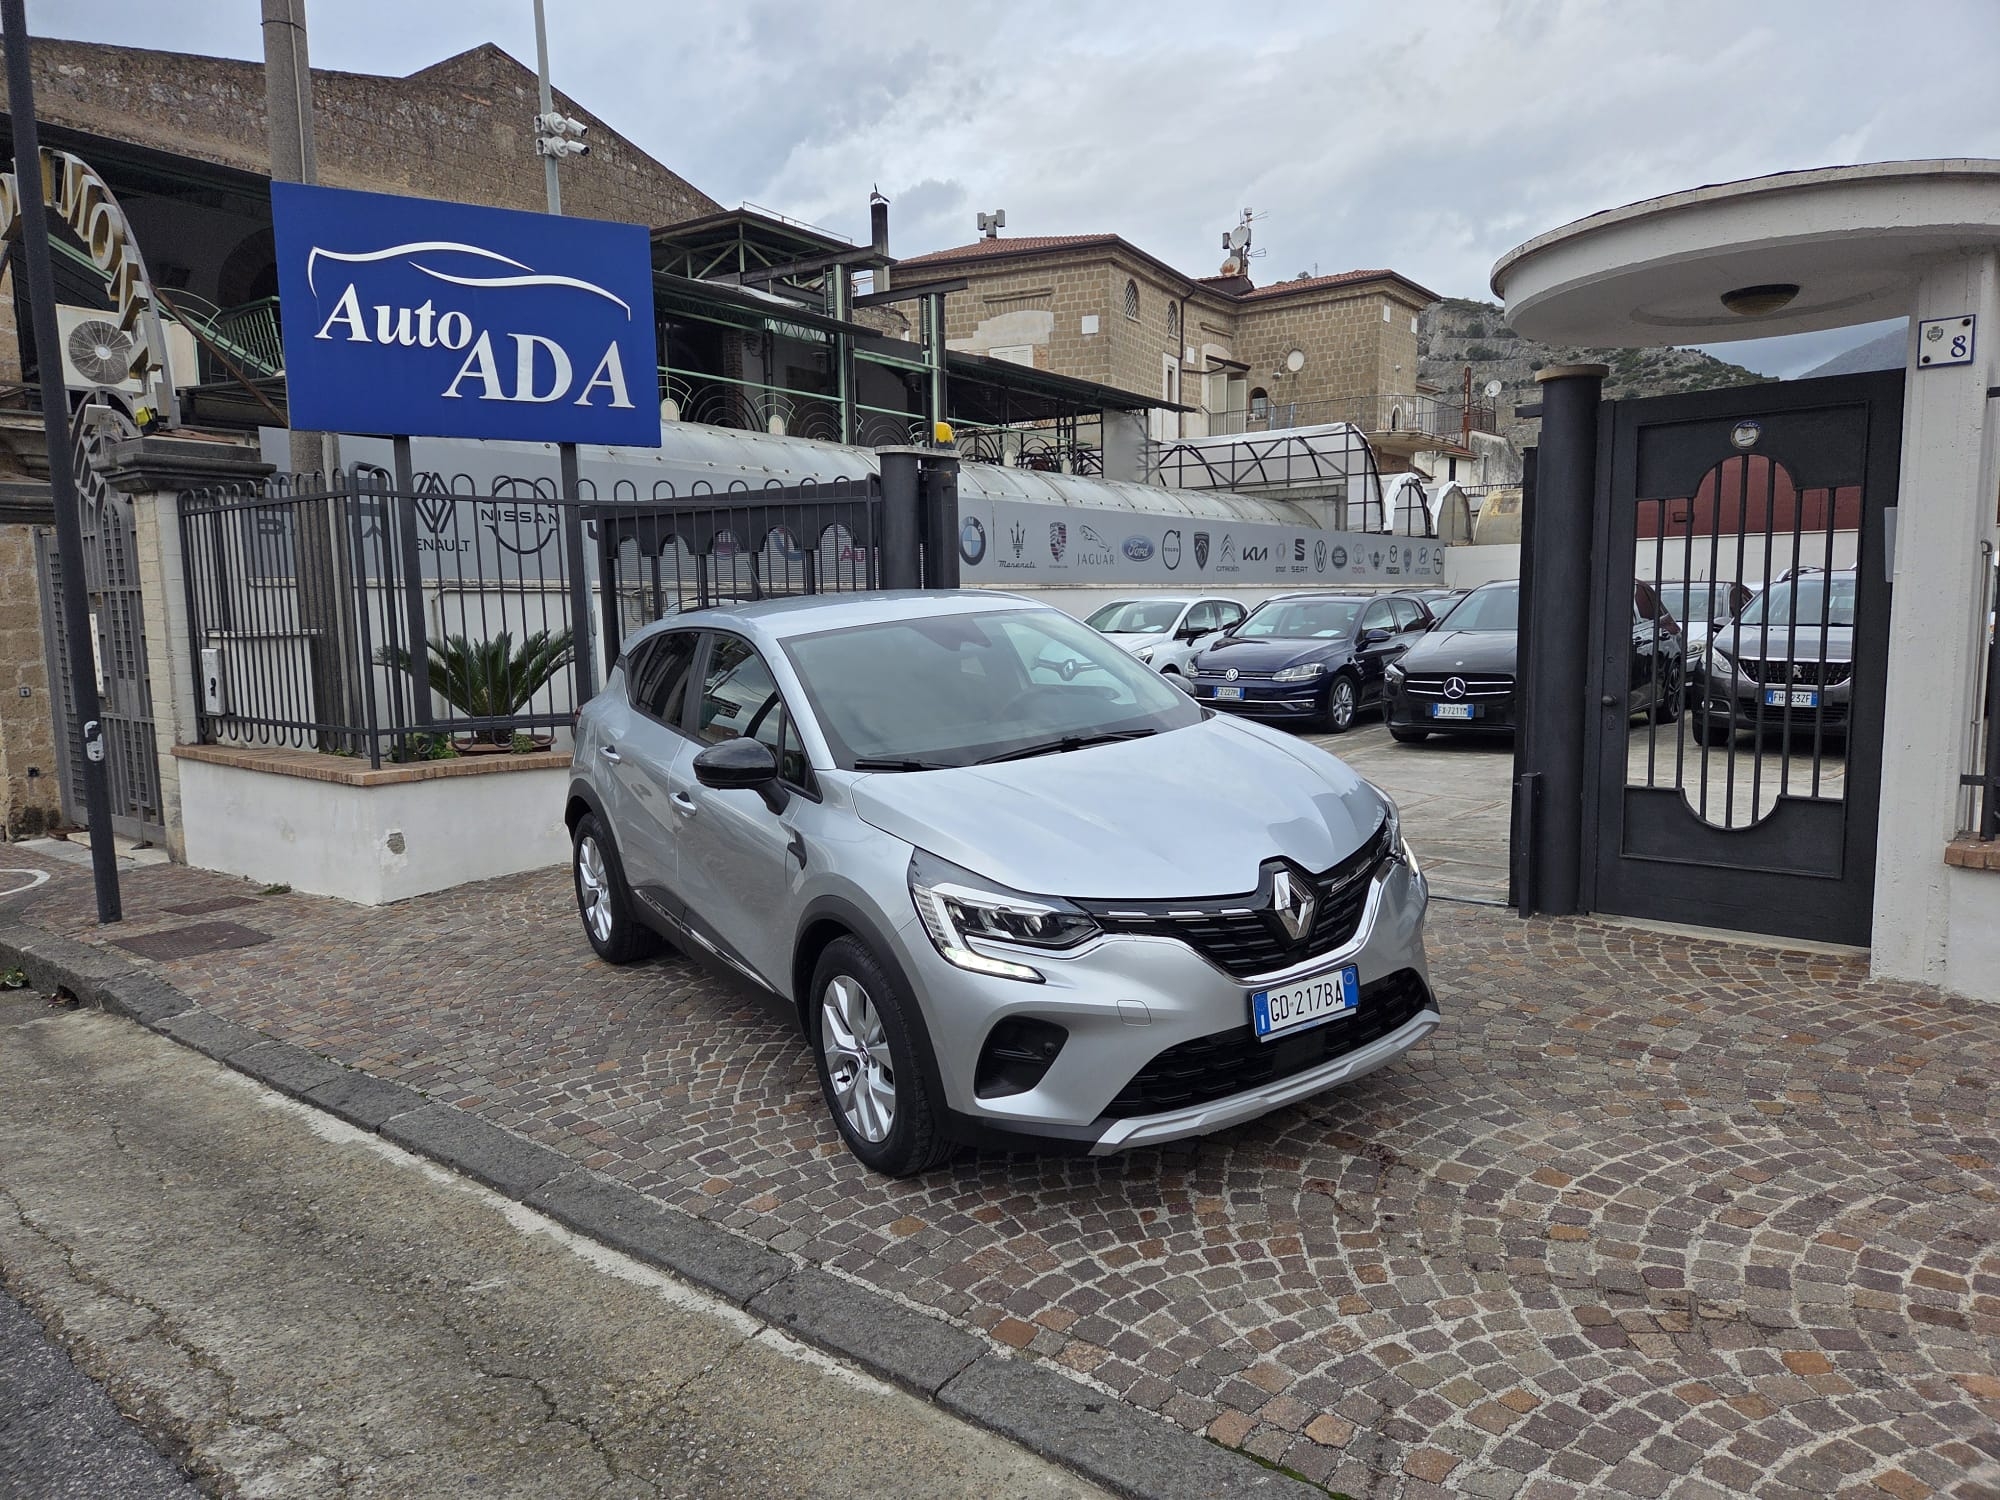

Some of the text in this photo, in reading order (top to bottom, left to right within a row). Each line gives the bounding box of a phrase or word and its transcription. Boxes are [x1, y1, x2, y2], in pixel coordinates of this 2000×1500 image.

[314, 282, 472, 350] Auto
[1951, 335, 1966, 358] 8
[441, 329, 636, 409] ADA
[480, 508, 561, 525] NISSAN
[416, 538, 470, 552] ENAULT
[1077, 553, 1115, 567] JAGUAR
